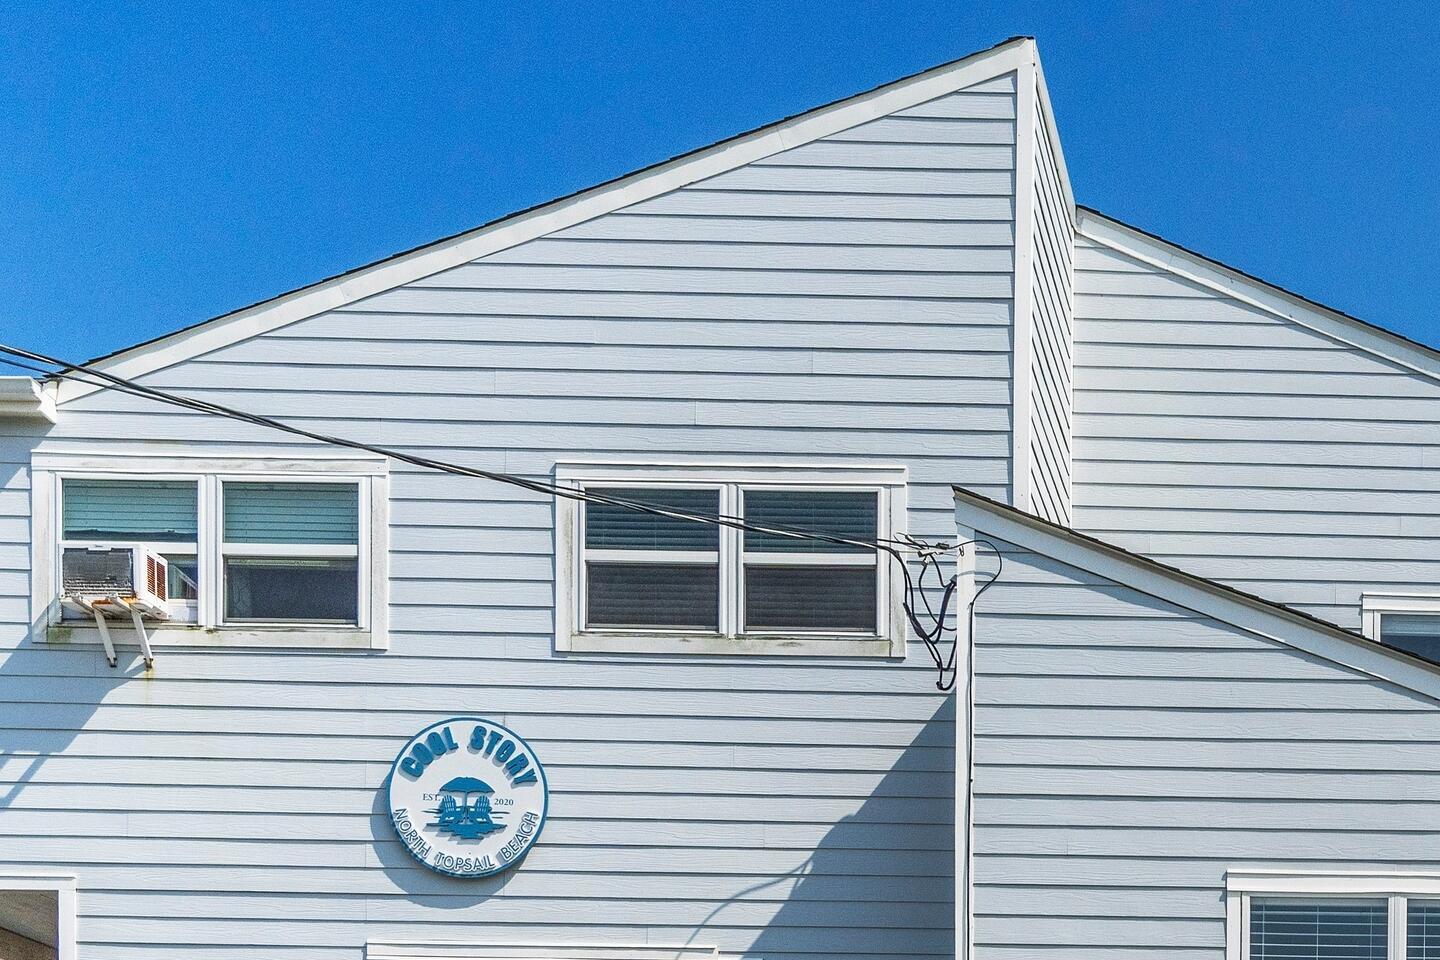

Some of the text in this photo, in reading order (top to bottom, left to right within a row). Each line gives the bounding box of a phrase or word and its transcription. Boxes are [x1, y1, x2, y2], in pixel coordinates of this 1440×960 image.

[399, 725, 539, 785] COOL STORY
[494, 798, 514, 806] 2020
[393, 808, 539, 872] NORTH TOPSAIL BEACH
